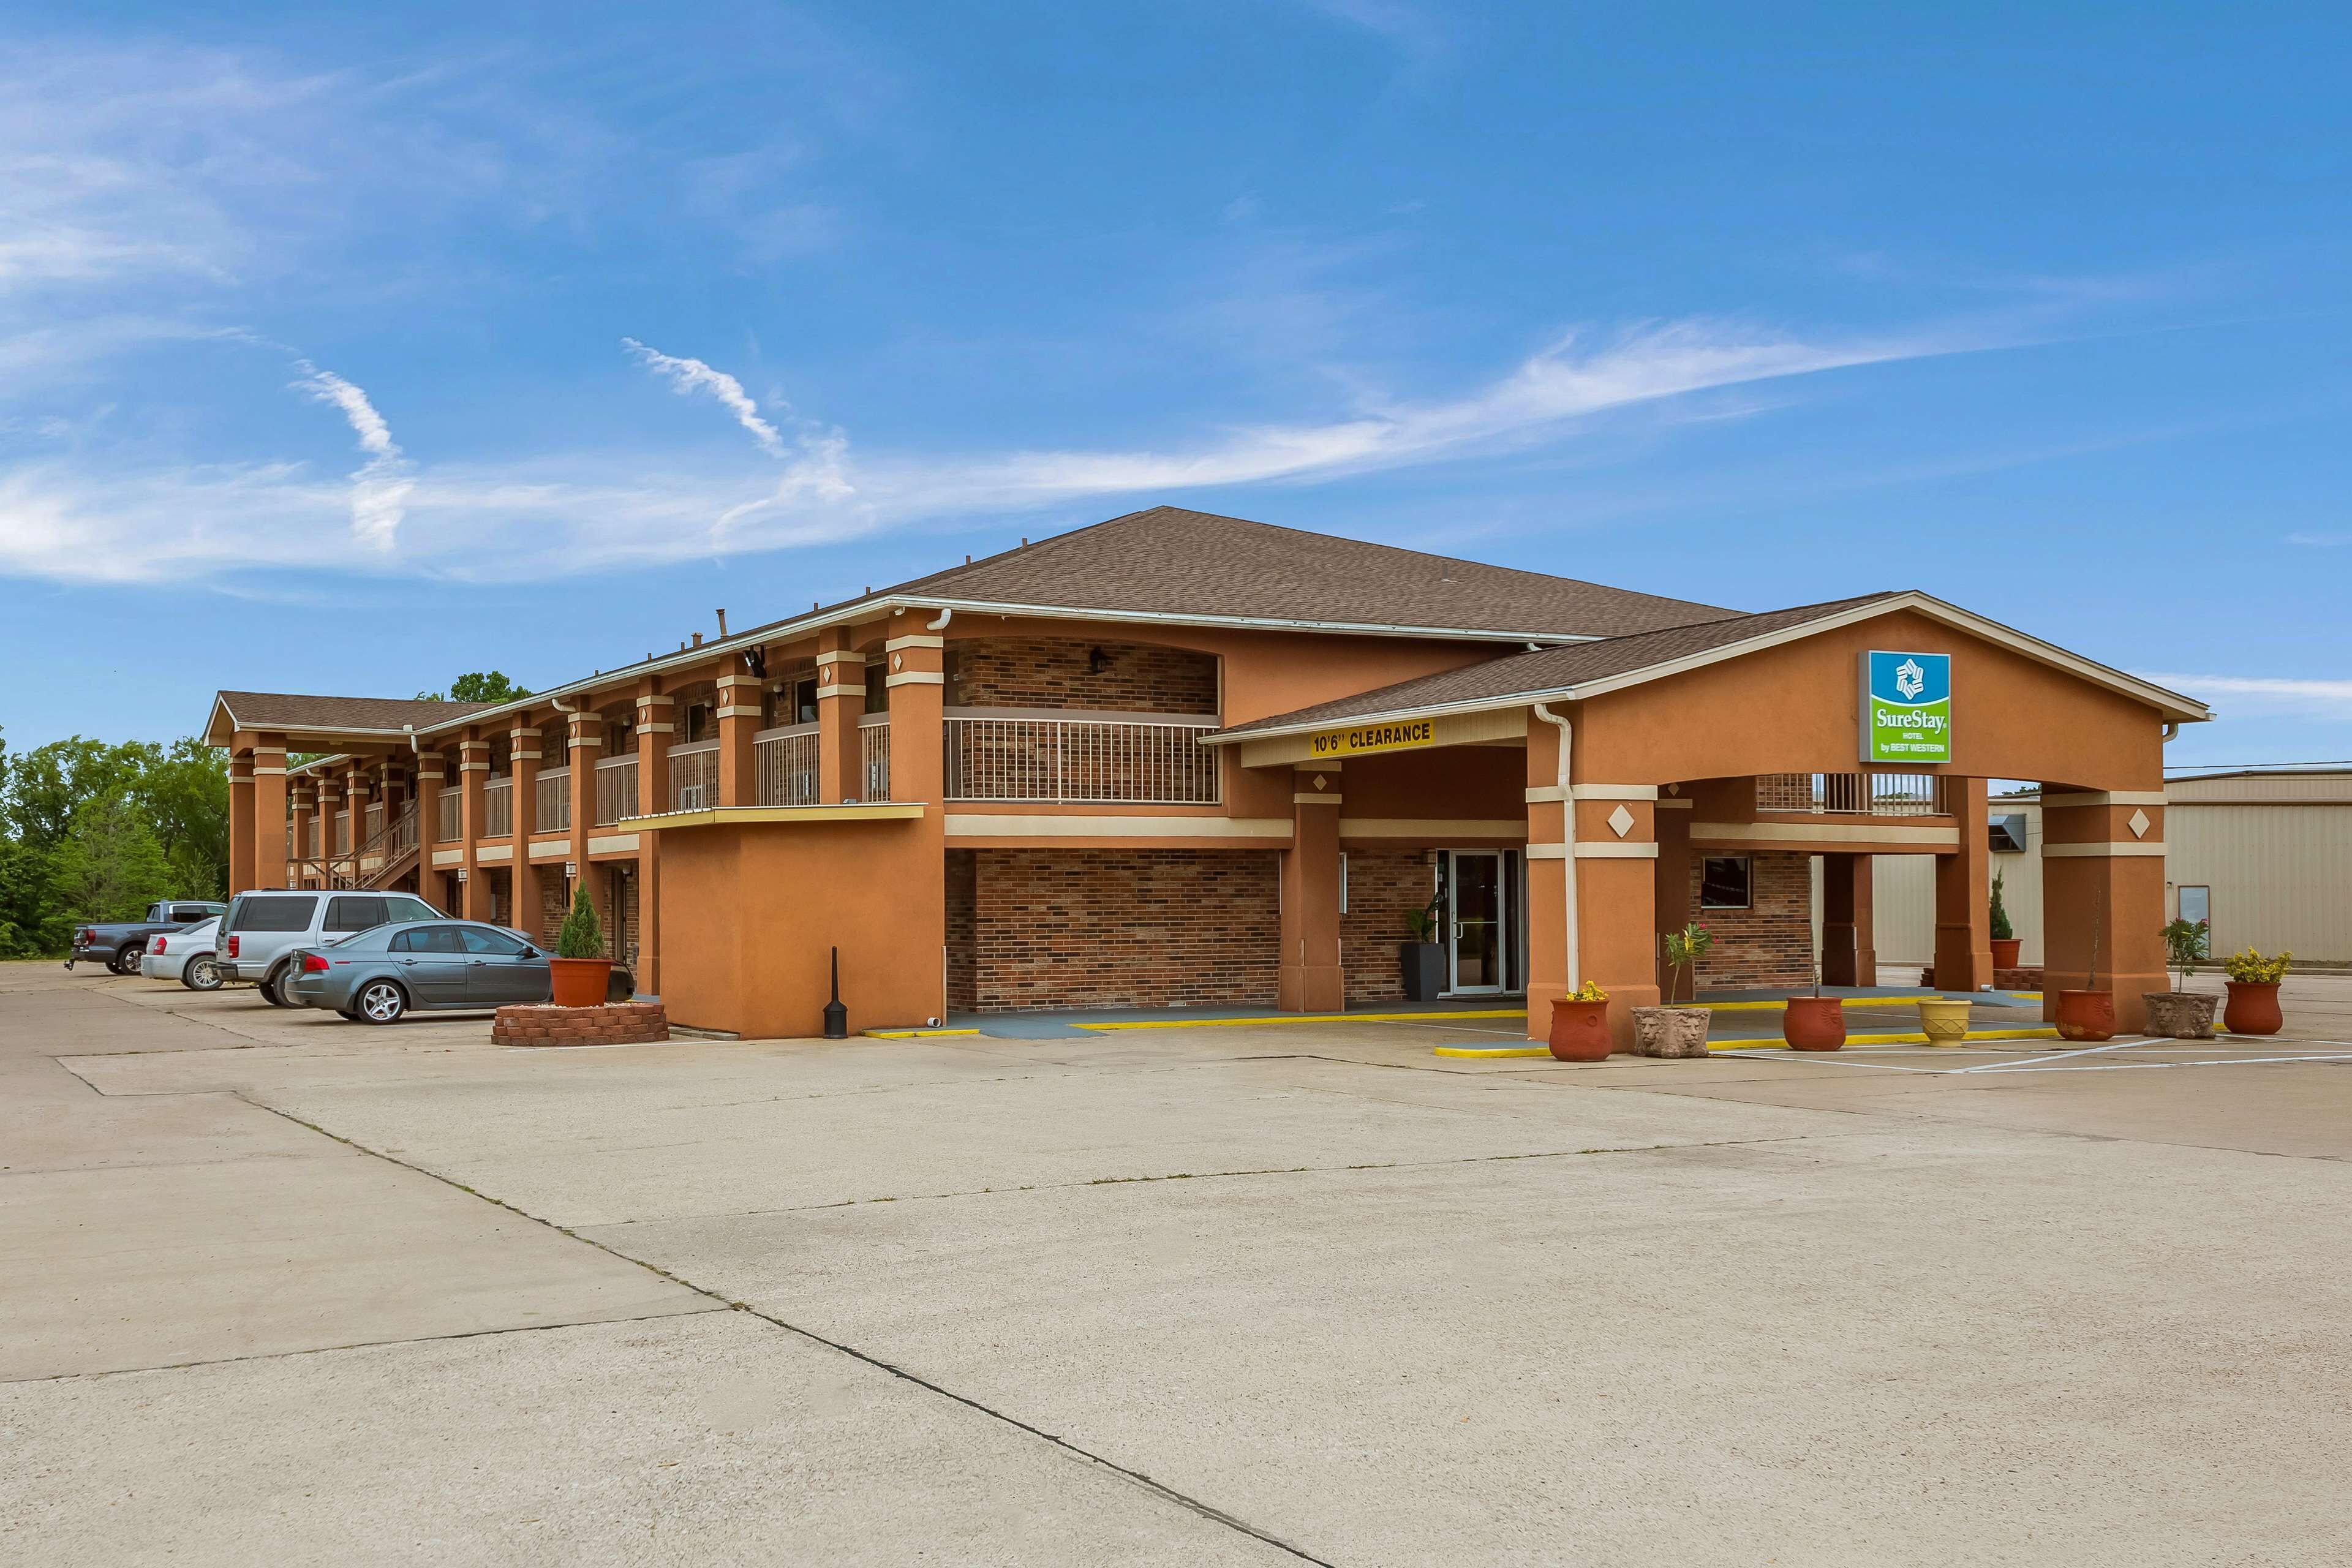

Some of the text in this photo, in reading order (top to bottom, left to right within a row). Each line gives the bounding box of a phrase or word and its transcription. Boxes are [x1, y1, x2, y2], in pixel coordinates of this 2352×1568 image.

[1877, 709, 1945, 734] SureStay
[1350, 723, 1430, 748] CLEARANCE
[1881, 743, 1890, 753] by
